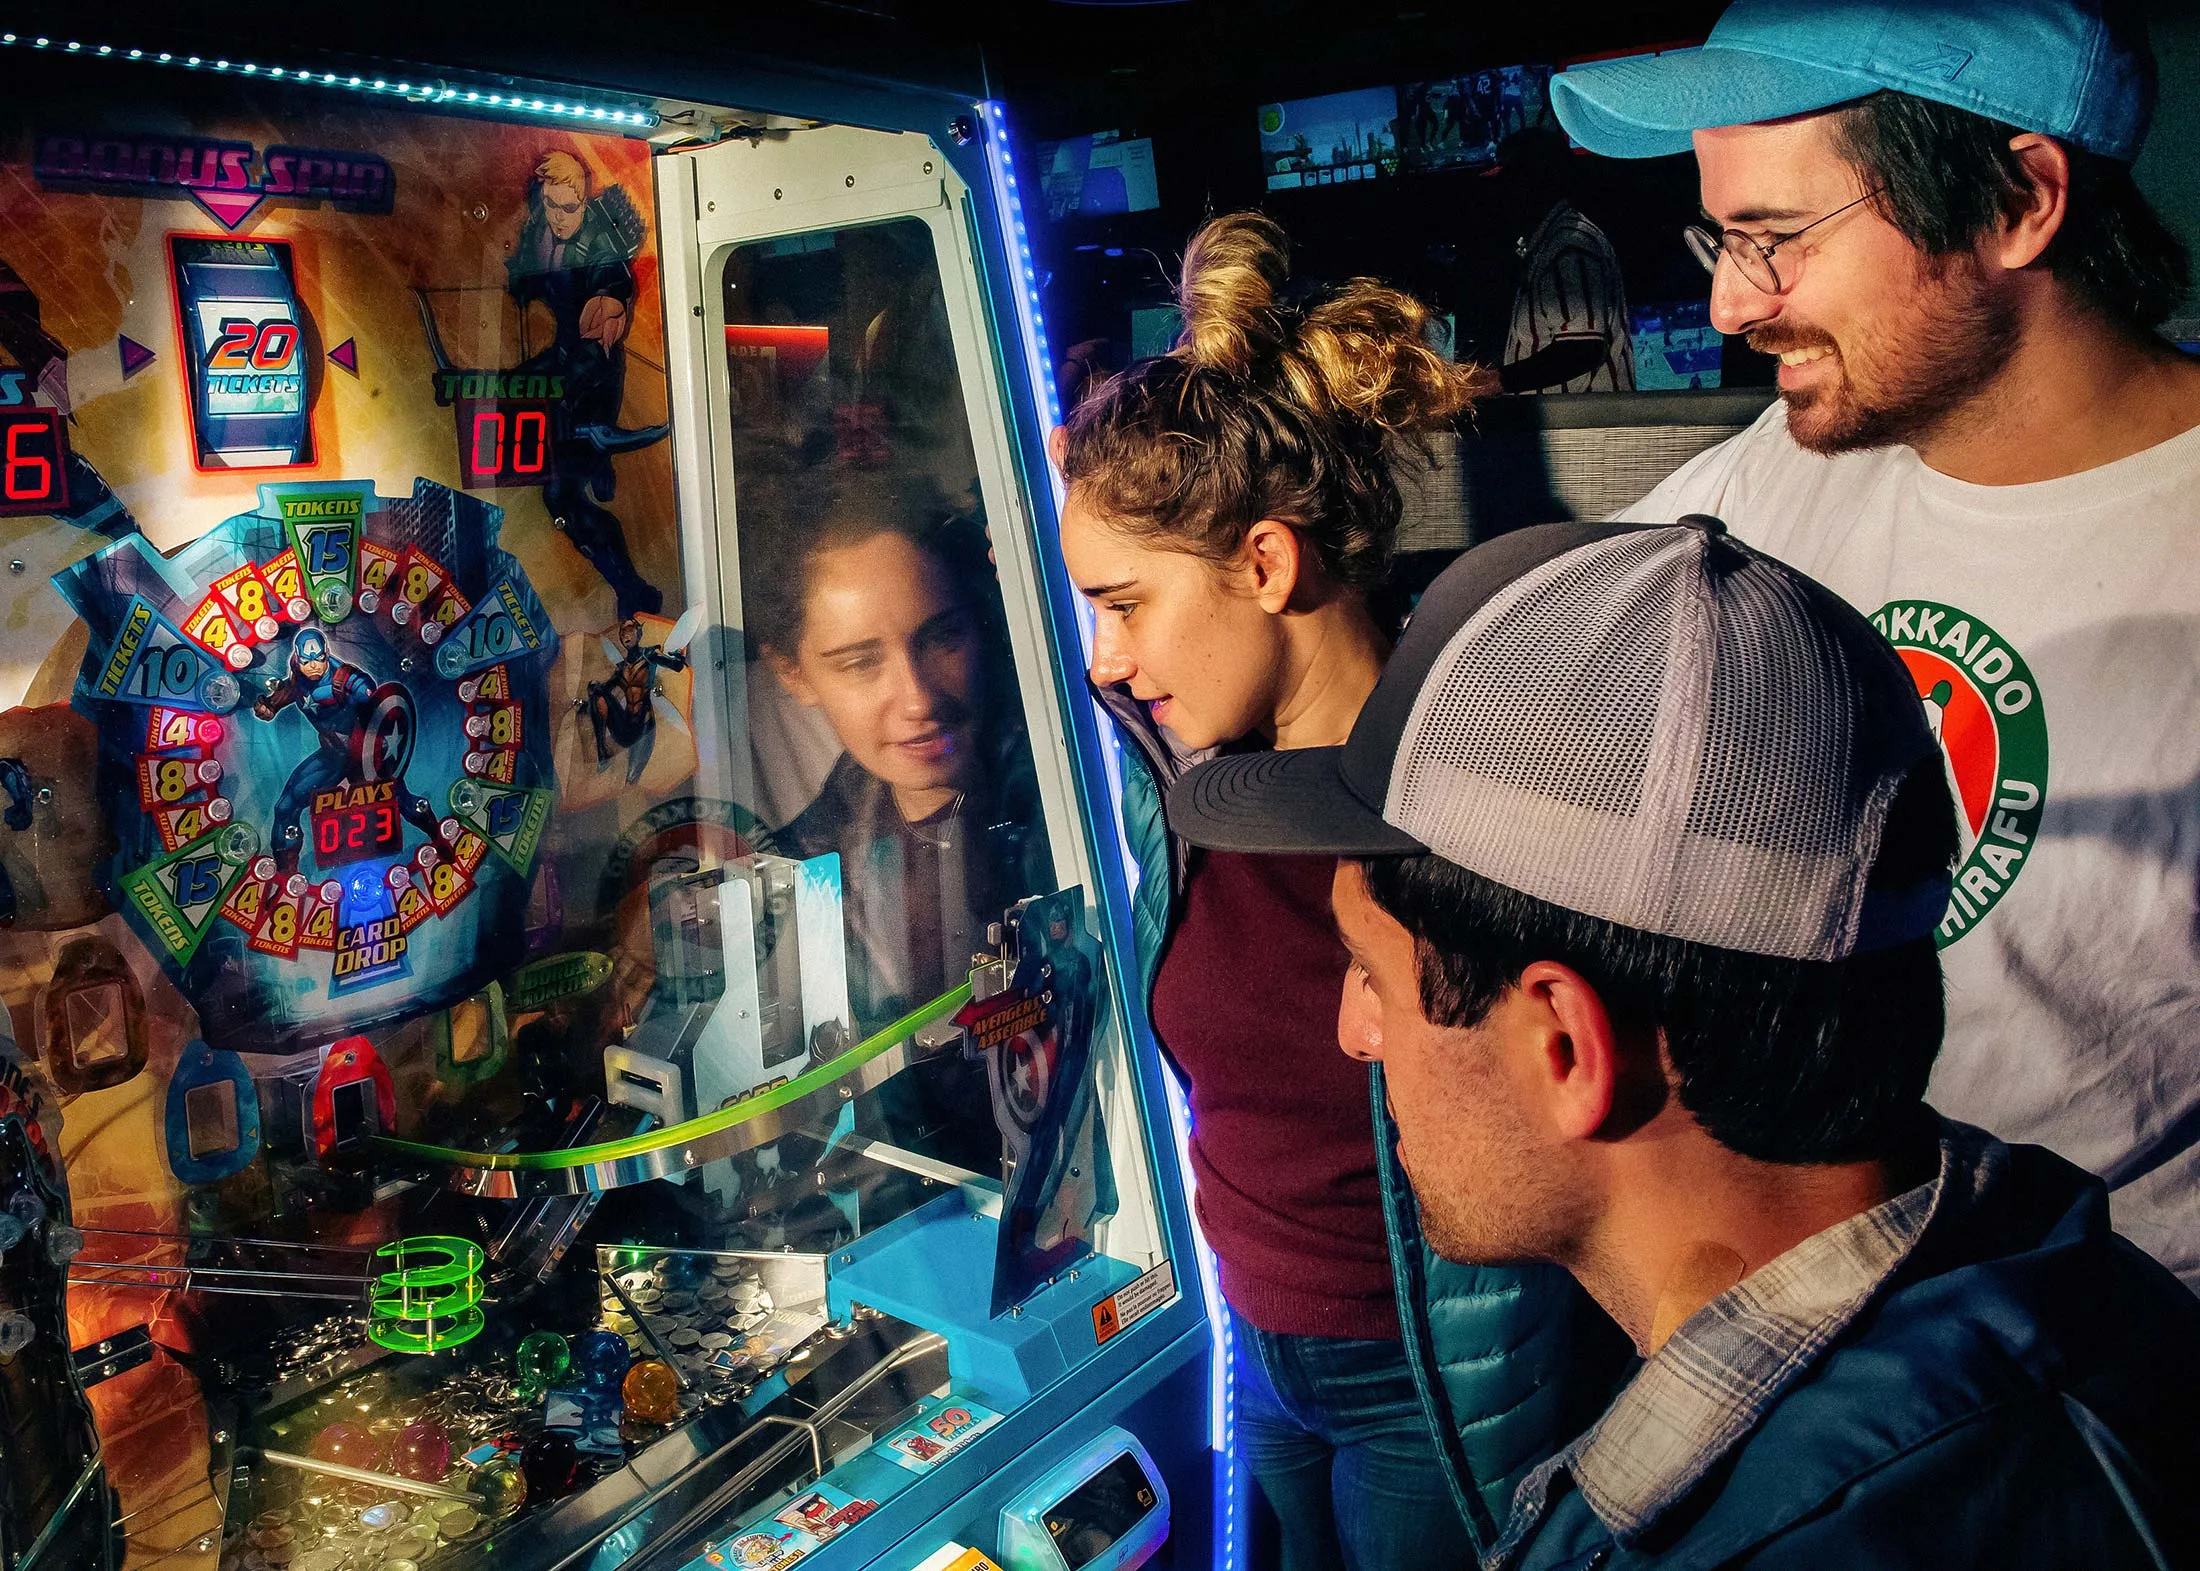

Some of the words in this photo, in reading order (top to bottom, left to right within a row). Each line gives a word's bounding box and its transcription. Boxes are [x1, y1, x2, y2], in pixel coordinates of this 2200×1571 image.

[38, 138, 250, 189] BONUS
[264, 153, 388, 195] SPIN
[205, 318, 299, 370] 20
[207, 375, 300, 394] TICKETS
[442, 375, 565, 399] TOKENS
[472, 411, 545, 474] 00
[285, 500, 360, 517] TOKENS
[260, 550, 296, 577] TOKENS
[302, 526, 351, 575] 15
[363, 543, 398, 561] TOKENS
[414, 551, 444, 575] TOKENS
[216, 564, 253, 591] TOKENS
[273, 566, 297, 598] 4
[364, 558, 386, 589] 4
[404, 562, 429, 603] 8
[184, 598, 214, 633] TOKENS
[236, 577, 264, 621] 8
[436, 598, 456, 626] 4
[498, 580, 541, 649] TICKETS
[201, 615, 227, 648] 4
[468, 611, 513, 658] 10
[99, 603, 152, 696] TICKETS
[1872, 606, 2032, 715] OKKAIDO
[140, 645, 198, 697] 10
[480, 672, 499, 699] 4
[150, 707, 162, 749] TOKENS
[164, 716, 189, 746] 4
[491, 709, 511, 744] 8
[155, 759, 186, 800] 8
[488, 752, 507, 778] 4
[139, 762, 153, 804] TOKENS
[315, 781, 394, 814] PLAYS
[175, 808, 201, 839] 4
[321, 808, 392, 853] 023
[483, 792, 524, 838] 15
[513, 794, 546, 866] TOKENS
[158, 813, 177, 852] TOKENS
[455, 833, 474, 859] 4
[466, 842, 487, 873] TOKENS
[168, 855, 222, 908] 15
[235, 882, 261, 914] 4
[431, 863, 454, 900] 8
[440, 885, 467, 911] TOKENS
[132, 879, 191, 951] TOKENS
[220, 907, 255, 930] TOKENS
[399, 888, 419, 916] 4
[269, 902, 296, 942] 8
[310, 907, 332, 937] 4
[337, 917, 400, 950] CARD
[402, 907, 430, 931] TOKENS
[254, 939, 290, 954] TOKENS
[299, 936, 334, 947] TOKENS
[335, 937, 407, 976] DROP
[927, 1407, 972, 1438] 50
[946, 1417, 981, 1442] TICKETS
